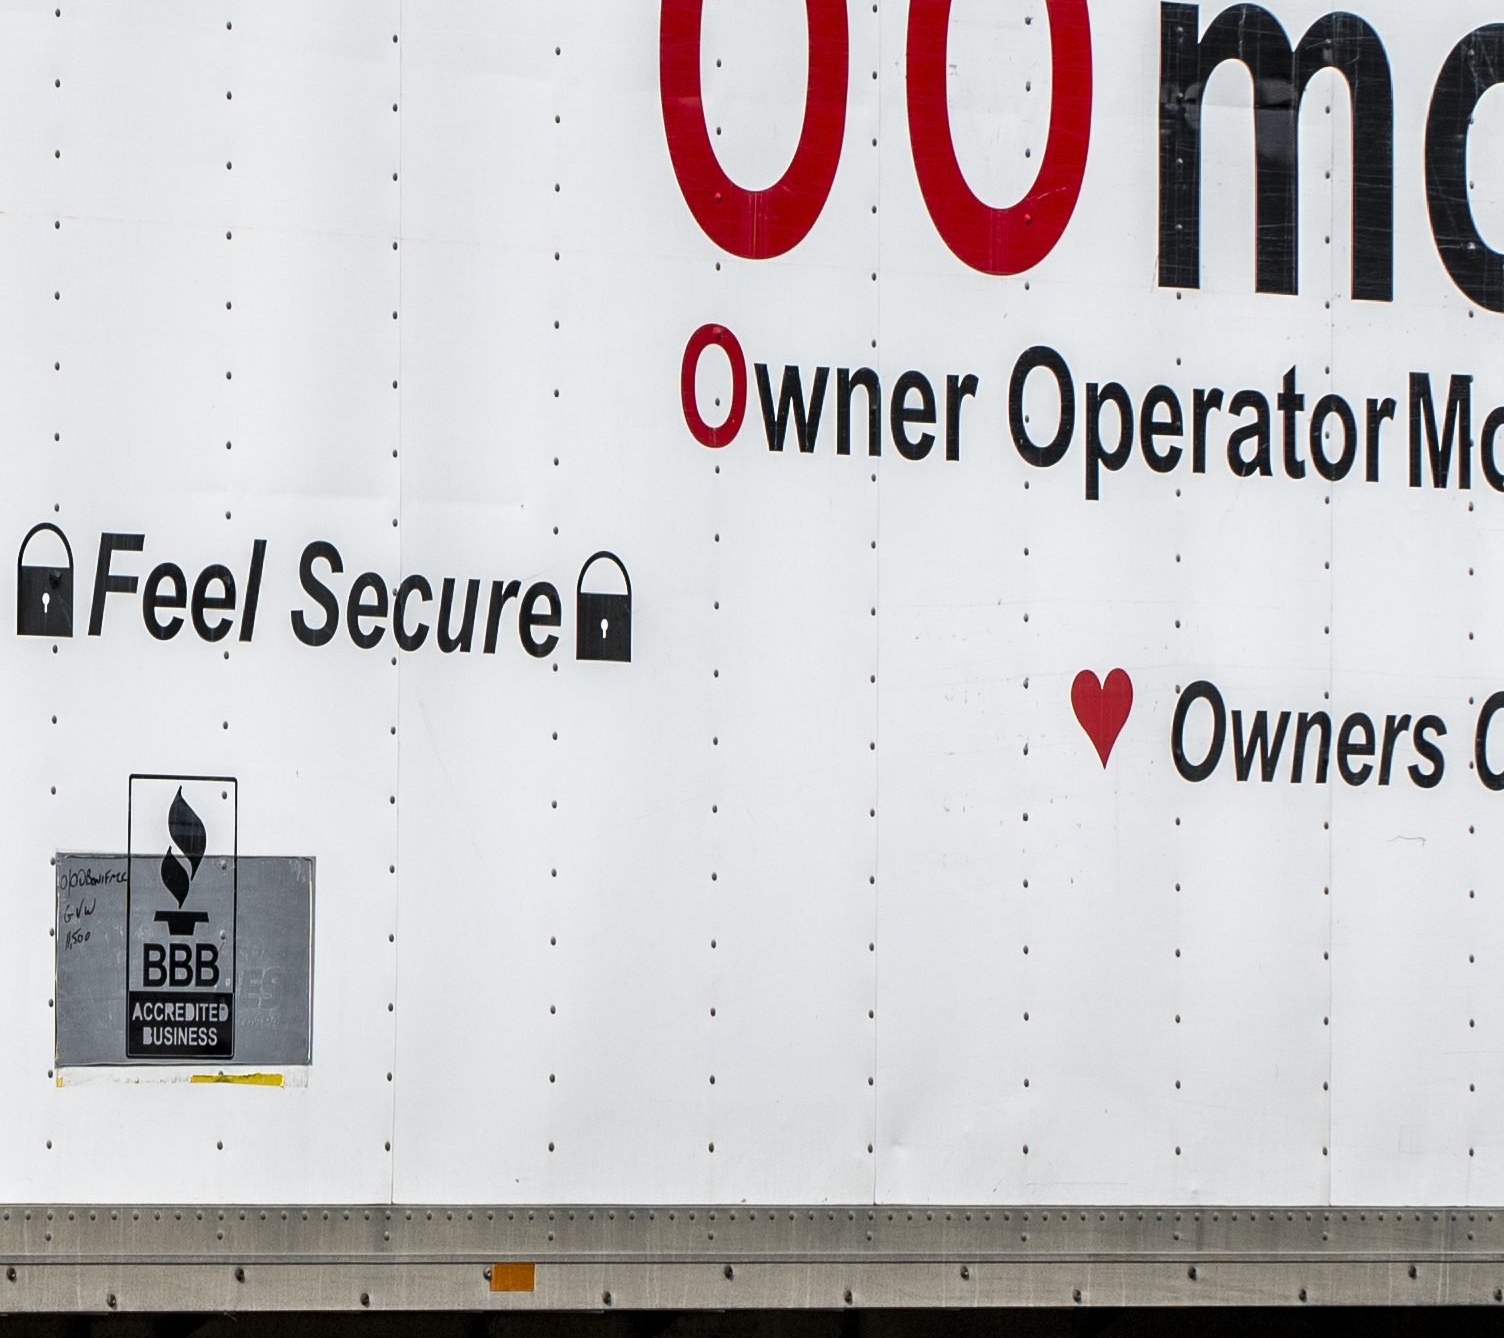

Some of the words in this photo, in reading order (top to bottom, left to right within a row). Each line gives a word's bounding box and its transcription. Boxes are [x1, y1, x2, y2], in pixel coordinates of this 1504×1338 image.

[681, 324, 980, 462] Owner
[1008, 345, 1397, 501] Operator
[88, 532, 267, 642] Feel
[291, 540, 562, 659] Secure
[1171, 680, 1447, 788] Owners
[143, 943, 220, 987] BBB
[132, 1003, 229, 1022] ACCREDITED
[142, 1027, 218, 1046] BUSINESS
